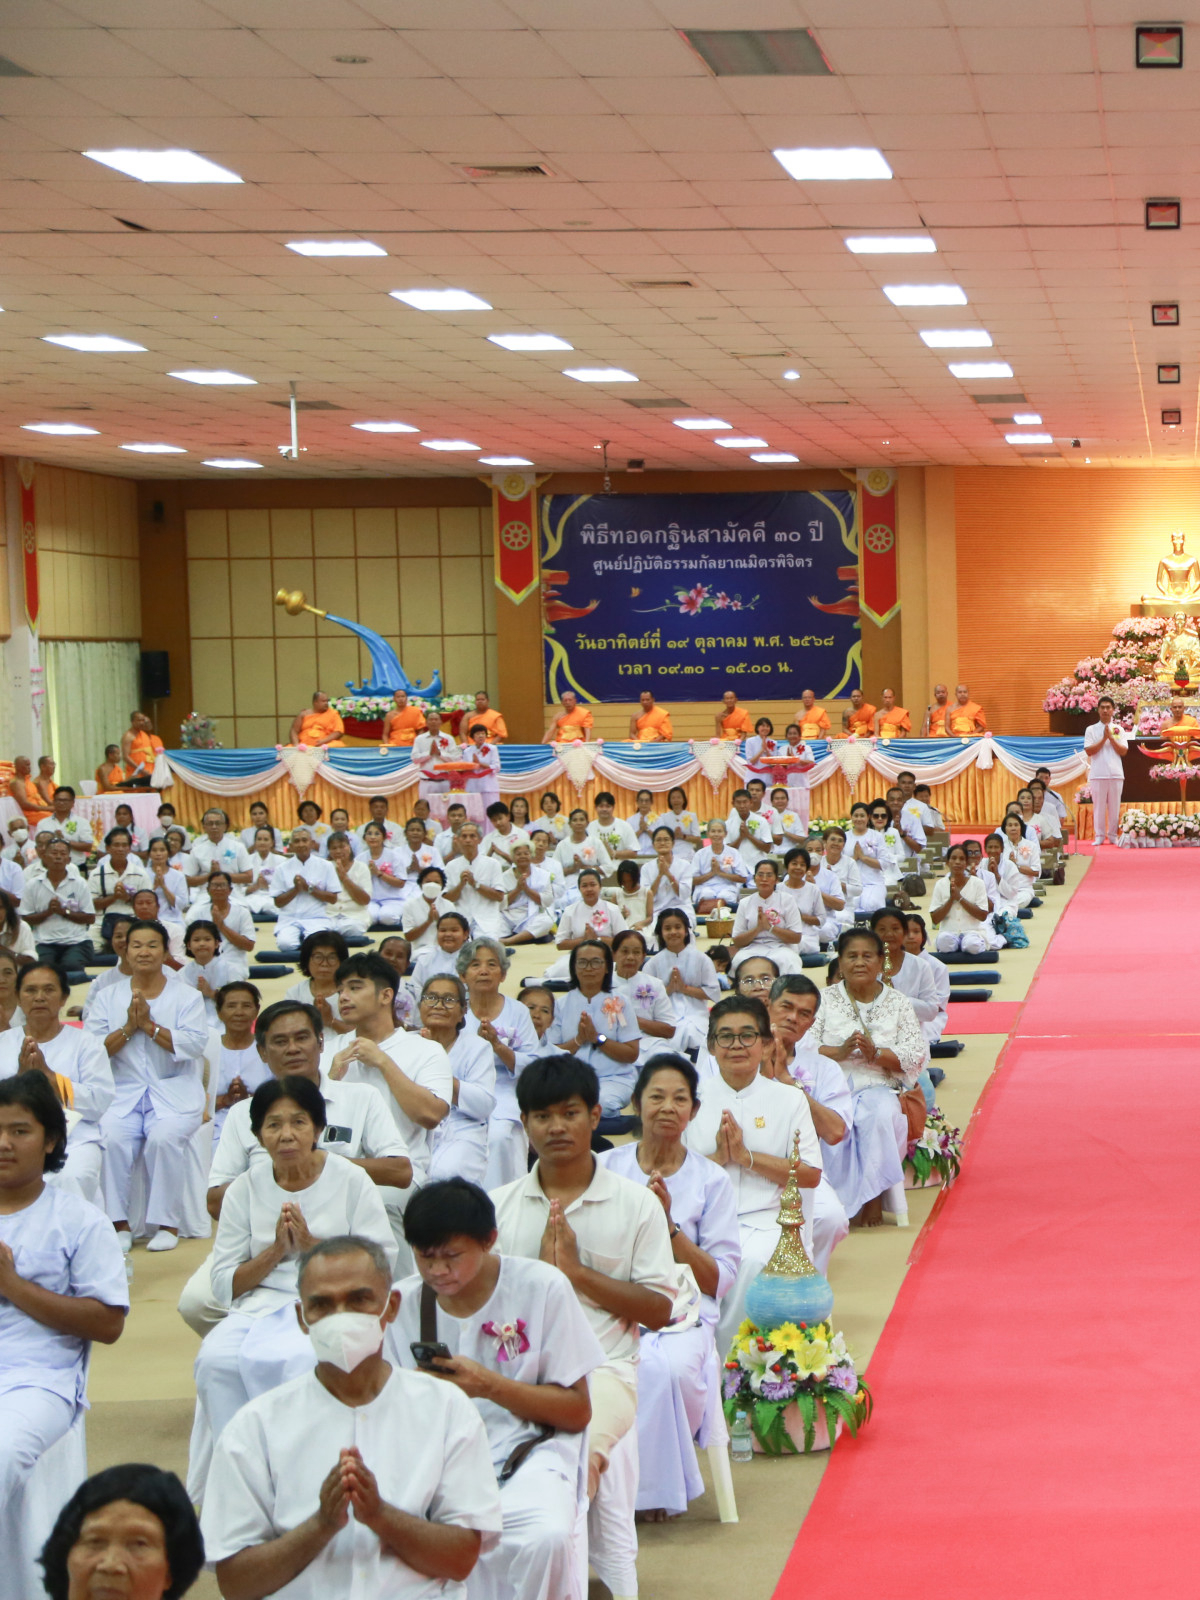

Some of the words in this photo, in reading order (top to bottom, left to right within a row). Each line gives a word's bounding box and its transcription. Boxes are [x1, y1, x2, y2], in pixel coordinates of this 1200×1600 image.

[580, 520, 766, 551] พิธีทอดกฐินสามัคคี
[774, 531, 801, 543] ๓๐
[808, 519, 824, 542] ปี
[575, 628, 661, 650] วันอาทิตย์ที่
[666, 637, 690, 649] ๑๙
[695, 637, 747, 654] ตุลาคม
[753, 635, 784, 648] พ.ศ.
[789, 634, 835, 647] ๒๕๖๘
[618, 663, 652, 676] เวลา
[657, 663, 705, 675] ๐๙.๓๐
[725, 662, 772, 675] ๑๕.๐๐
[777, 661, 793, 674] น.
